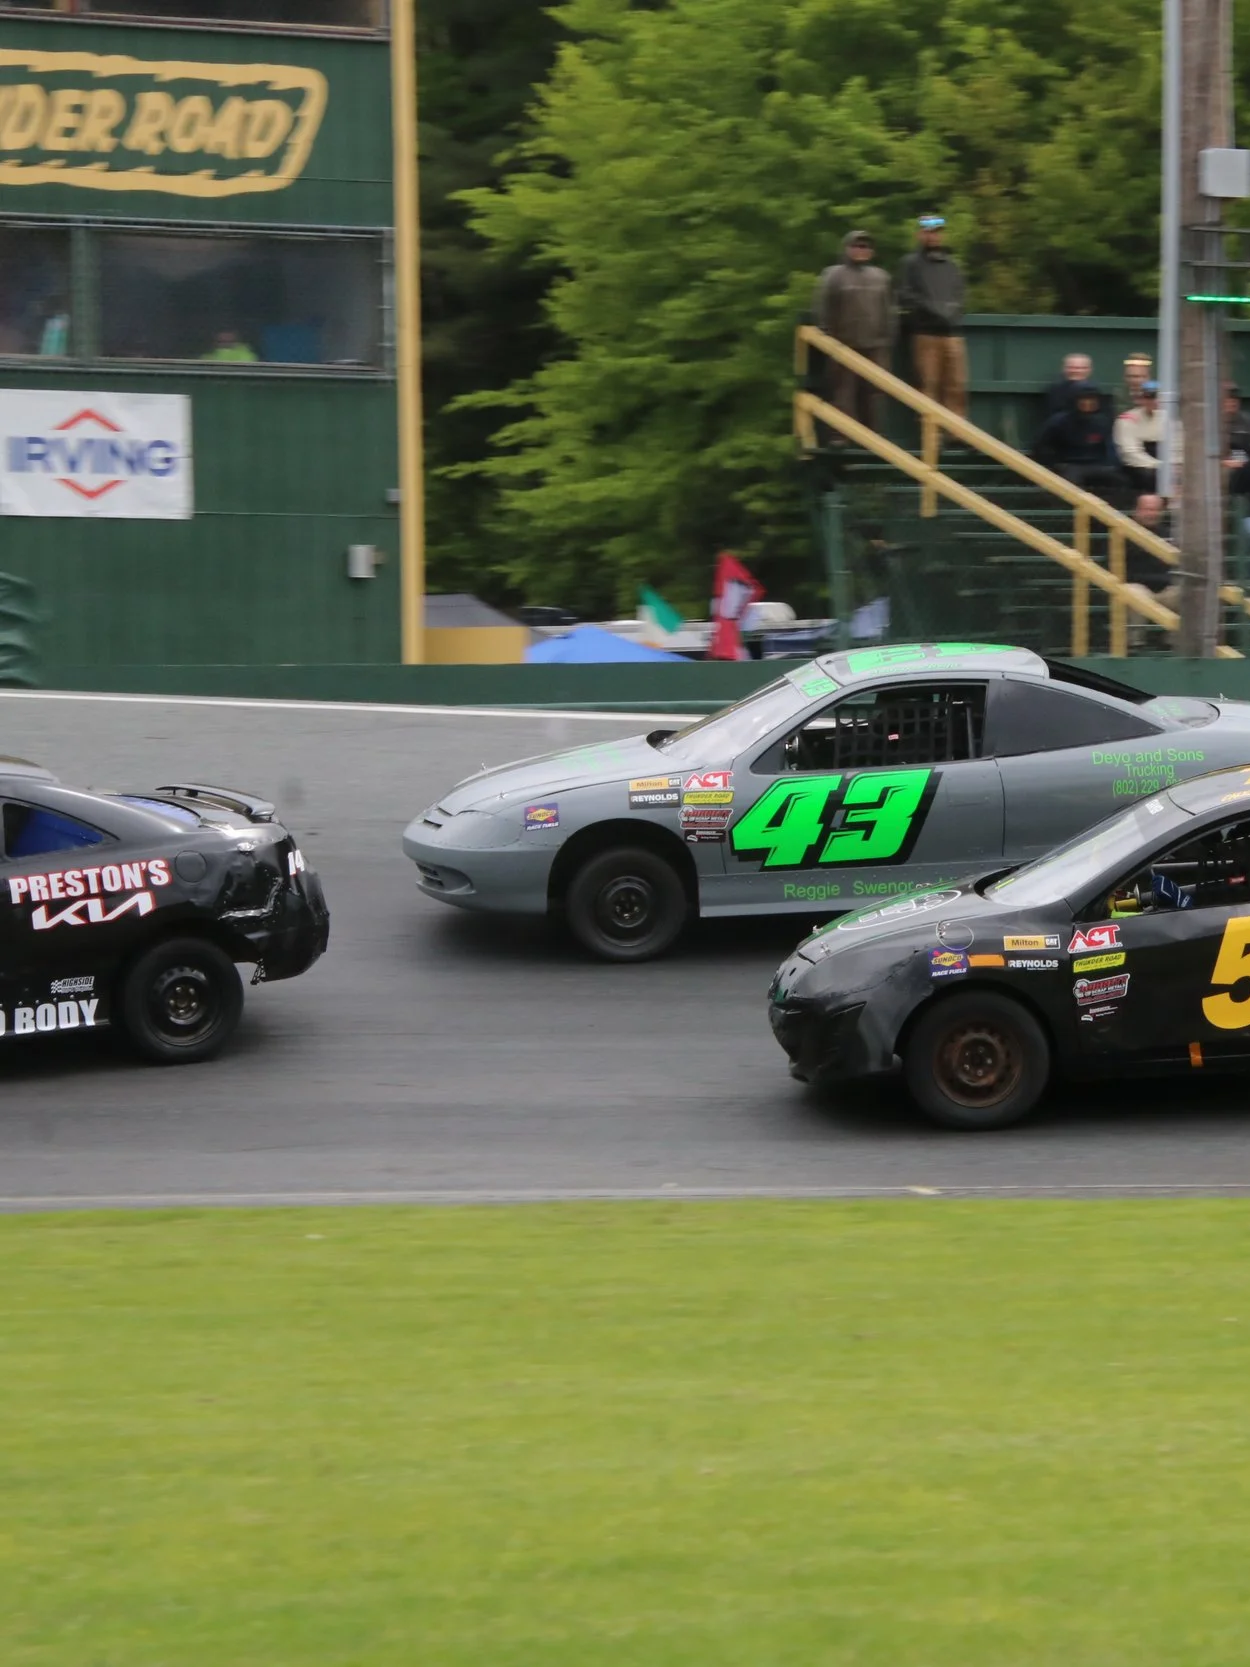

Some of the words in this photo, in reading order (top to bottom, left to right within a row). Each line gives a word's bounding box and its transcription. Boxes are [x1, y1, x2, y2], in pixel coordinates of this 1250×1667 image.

[0, 84, 127, 152] DER
[122, 91, 294, 159] ROAD
[7, 436, 177, 477] IRVING
[1092, 751, 1130, 767] Deyo
[1135, 748, 1162, 762] and
[1167, 748, 1204, 761] Sons
[1124, 763, 1174, 778] Trucking
[684, 771, 733, 789] ACT
[1113, 779, 1139, 798] (802)
[631, 793, 679, 802] REYNOLDS
[731, 768, 941, 871] 43
[8, 860, 170, 904] PRESTON'S
[784, 882, 841, 900] Reggie
[1011, 939, 1039, 947] Milton
[1045, 938, 1058, 946] CAT
[1069, 926, 1120, 951] ACT
[932, 954, 964, 965] SUNOCO
[1008, 960, 1059, 968] REYNOLDS
[1075, 957, 1105, 967] THUNDER
[1105, 954, 1122, 963] ROAD
[62, 977, 94, 988] HIGHSIDE
[14, 999, 99, 1034] BODY
